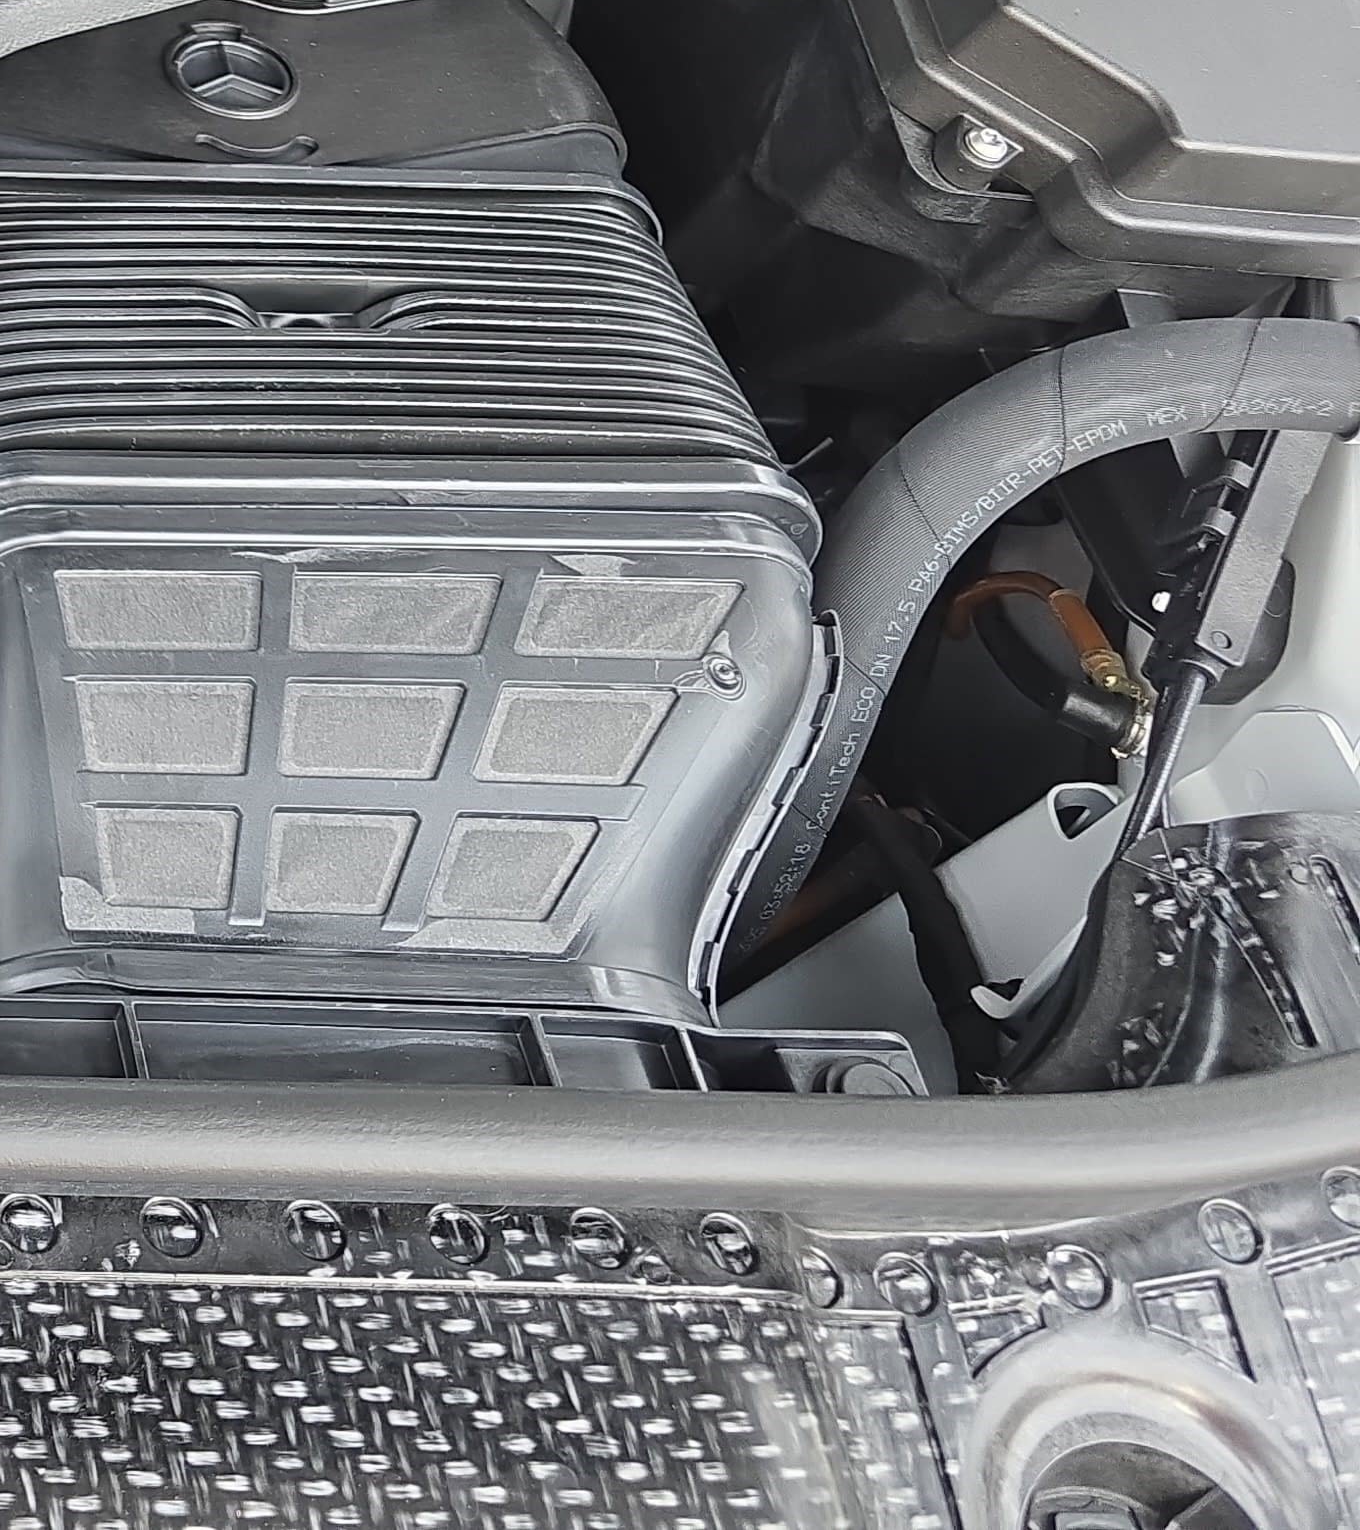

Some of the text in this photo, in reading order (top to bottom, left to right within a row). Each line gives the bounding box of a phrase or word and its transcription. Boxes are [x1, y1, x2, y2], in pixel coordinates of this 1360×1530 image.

[850, 685, 878, 723] ECO
[870, 654, 893, 678] DN
[884, 600, 917, 644] 17.5
[1146, 406, 1188, 427] MEX
